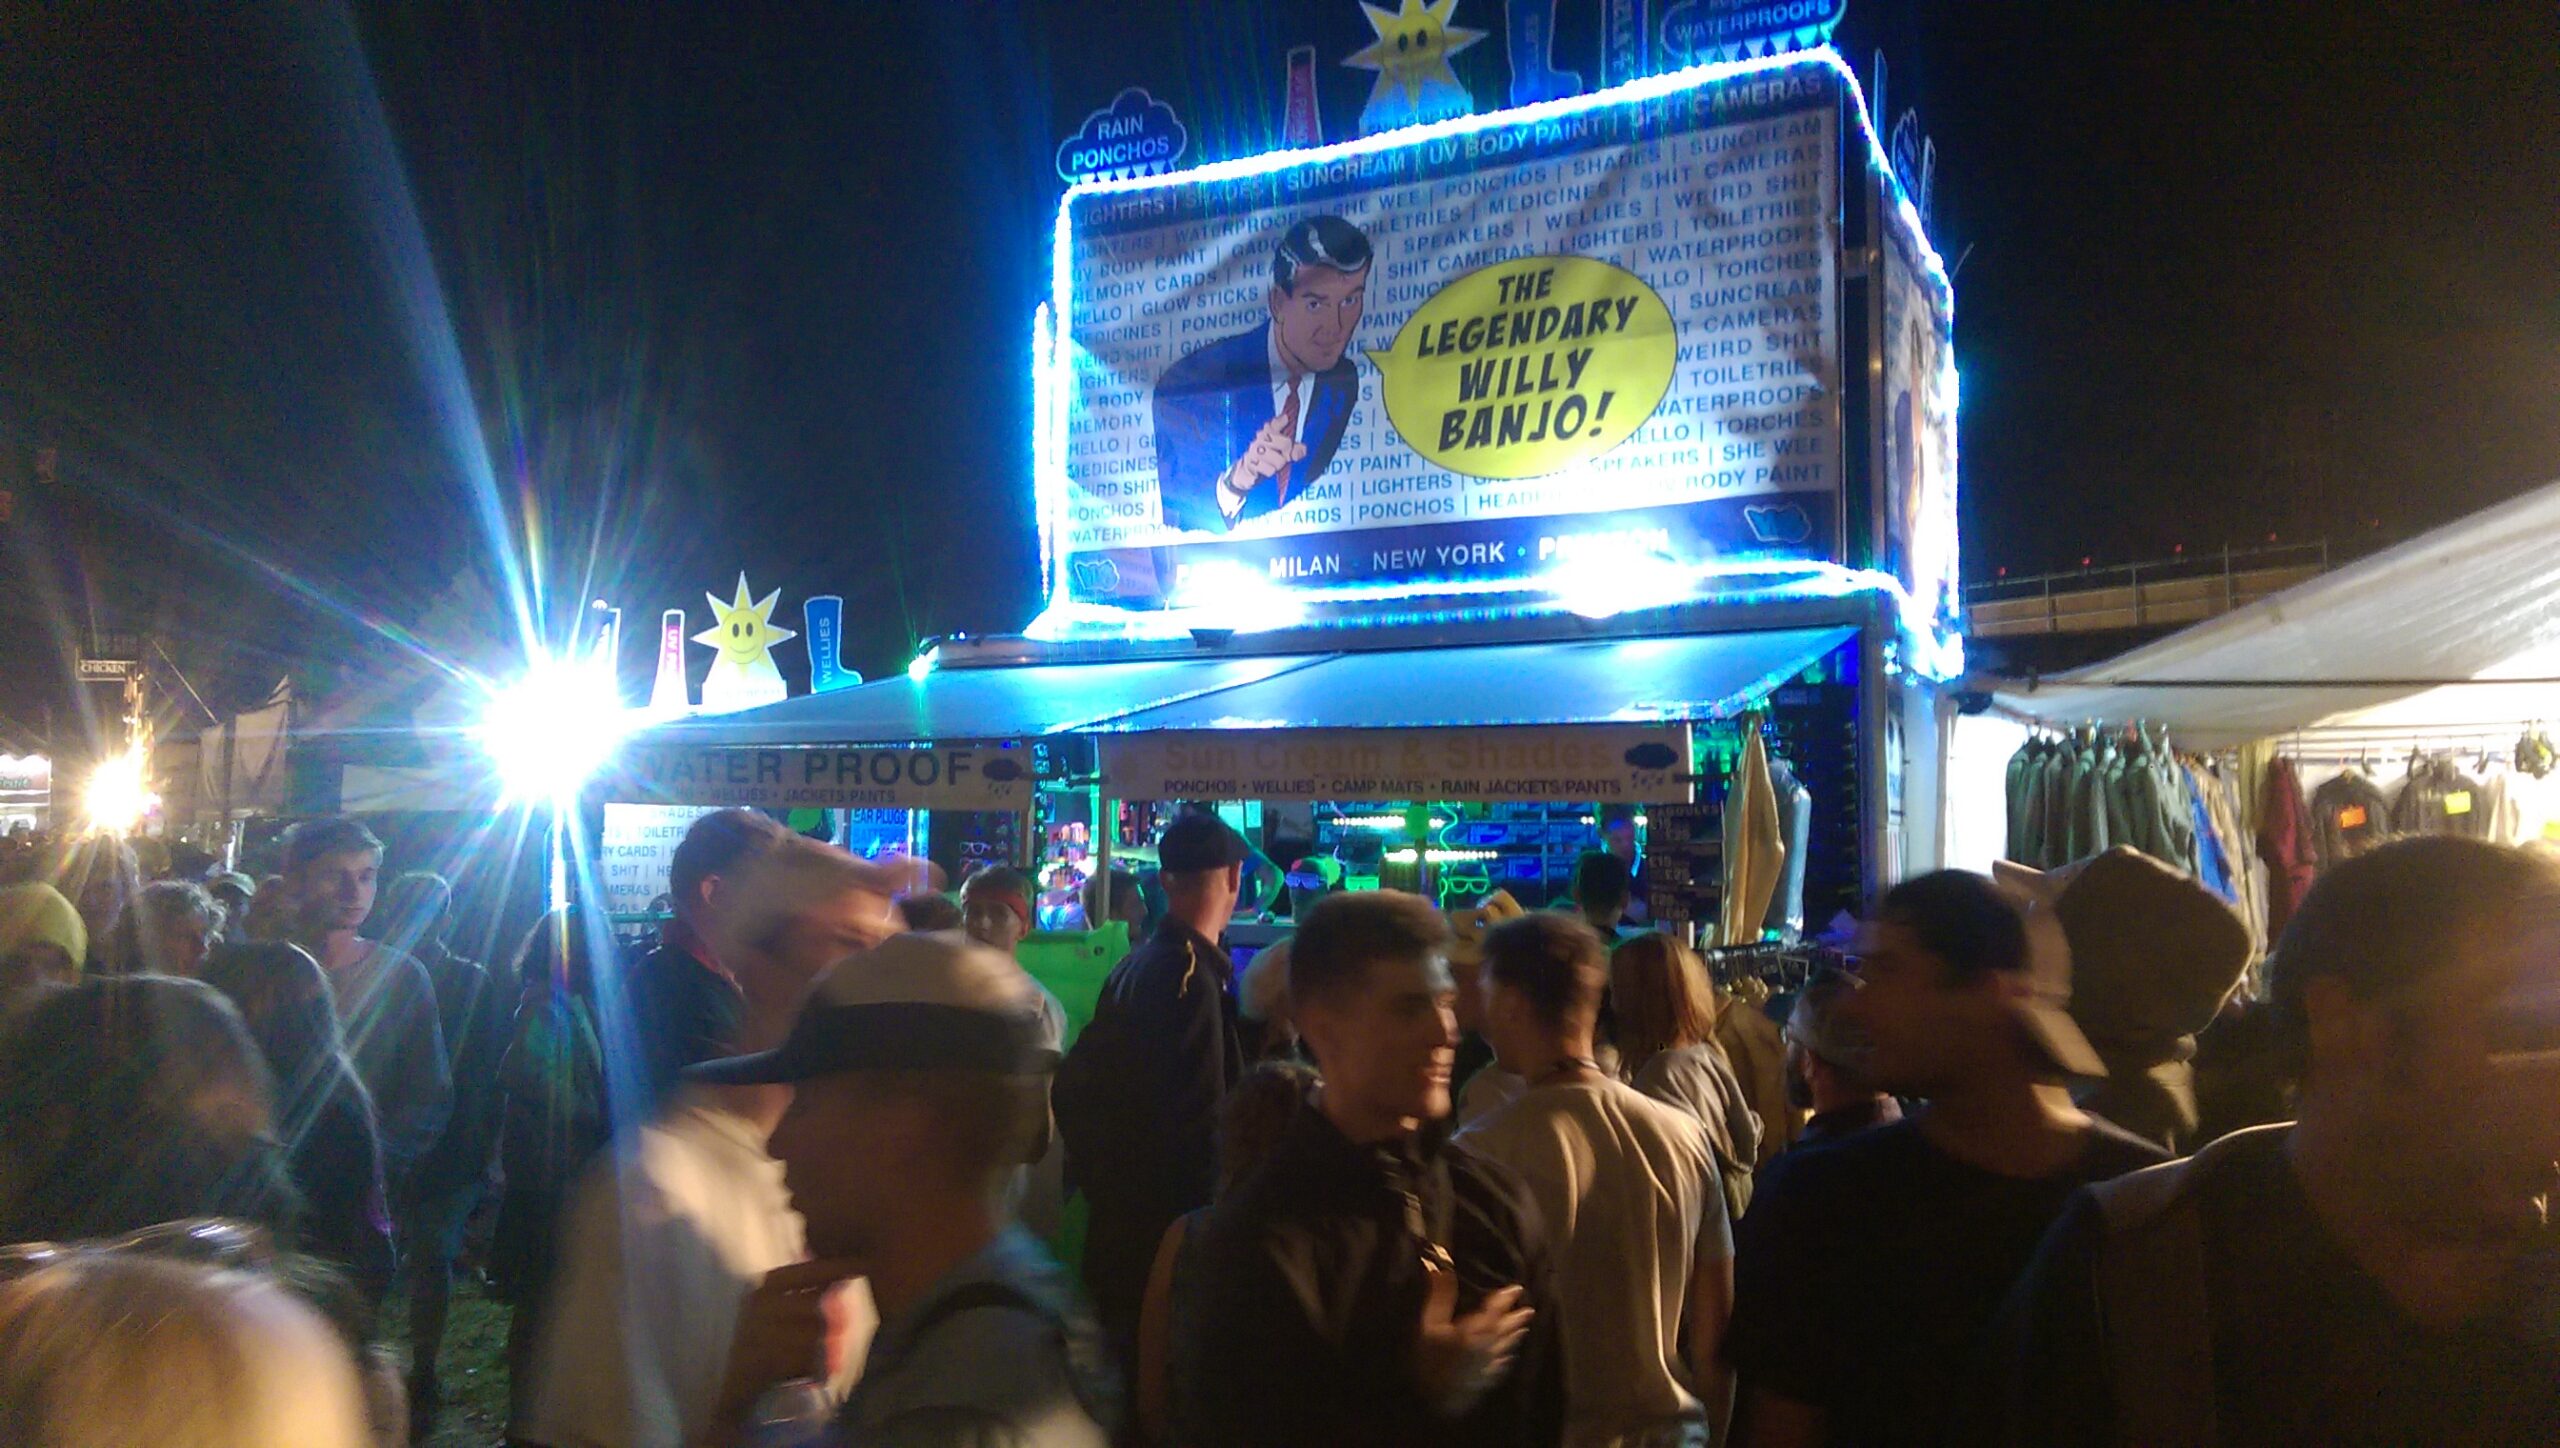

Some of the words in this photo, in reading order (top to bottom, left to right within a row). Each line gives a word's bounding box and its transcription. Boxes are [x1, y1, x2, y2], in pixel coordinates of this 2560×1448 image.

[1097, 114, 1144, 140] RAIN
[1286, 150, 1405, 192] SUNCREAM
[1429, 141, 1459, 164] UV
[1464, 127, 1530, 158] BODY
[1535, 116, 1603, 147] PAINT
[1695, 73, 1822, 116] CAMERAS
[1071, 136, 1170, 171] PONCHOS
[1081, 238, 1153, 263] IGHTERS
[1379, 190, 1422, 211] WEE
[1445, 168, 1546, 200] PONCHOS
[1101, 255, 1145, 279] BODY
[1155, 246, 1206, 271] PAINT
[1361, 205, 1461, 239] OILETRIES
[1488, 180, 1610, 216] MEDICINES
[1640, 167, 1691, 191] SHIT
[1705, 144, 1822, 180] CAMERAS
[1155, 270, 1216, 294] CARDS
[1404, 226, 1514, 254] SPEAKERS
[1546, 200, 1642, 231] WELLIES
[1675, 182, 1752, 209] WEIRD
[1766, 171, 1821, 196] SHIT
[1072, 304, 1122, 327] HELLO
[1142, 296, 1189, 317] GLOW
[1197, 285, 1259, 307] STICKS
[1388, 261, 1428, 280] SHIT
[1437, 243, 1535, 273] CAMERAS
[1559, 222, 1664, 255] LIGHTERS
[1498, 267, 1555, 307] THE
[1126, 345, 1162, 362] SHIT
[1717, 250, 1822, 281] TORCHES
[1181, 307, 1268, 333] PONCHOS
[1417, 296, 1640, 361] LEGENDARY
[1078, 370, 1151, 391] IGHTERS
[1689, 279, 1822, 311] SUNCREAM
[1098, 391, 1144, 410] BODY
[1704, 303, 1822, 334] CAMERAS
[1069, 413, 1144, 436] MEMORY
[1677, 339, 1752, 364] WEIRD
[1766, 330, 1822, 352] SHIT
[1459, 346, 1595, 405] WILLY
[1437, 390, 1617, 455] BANJO!
[1067, 457, 1158, 482] MEDICINES
[1069, 438, 1120, 458] HELLO
[1123, 478, 1158, 498] SHIT
[1360, 453, 1413, 473] PAINT
[1715, 410, 1824, 436] TORCHES
[1362, 473, 1453, 498] LIGHTERS
[1723, 442, 1766, 464] SHE
[1774, 435, 1819, 457] WEE
[1282, 504, 1342, 525] ARDS
[1358, 497, 1456, 520] PONCHOS
[1686, 468, 1745, 489] BODY
[1756, 462, 1824, 484] PAINT
[1269, 555, 1340, 579] MILAN
[1374, 547, 1427, 571] NEW
[1436, 540, 1505, 567] YORK
[80, 663, 126, 674] CHICKEN
[817, 616, 833, 685] WELLIES
[802, 748, 973, 786] PROOF
[1165, 741, 1237, 770] Sun
[1254, 741, 1383, 770] Cream
[1446, 741, 1613, 770] Shades
[711, 786, 768, 800] WELLIES
[784, 787, 846, 803] JACKETS
[850, 788, 896, 803] PANTS
[1164, 779, 1238, 795] PONCHOS
[1252, 779, 1315, 795] WELLIES
[1331, 779, 1377, 795] CAMP
[1381, 779, 1424, 795] MATS
[1441, 779, 1480, 795] RAIN
[652, 806, 702, 819] HADES
[853, 808, 873, 823] EAR
[875, 808, 908, 825] PLUGS
[612, 863, 640, 877] SHIT
[618, 846, 657, 858] CARDS
